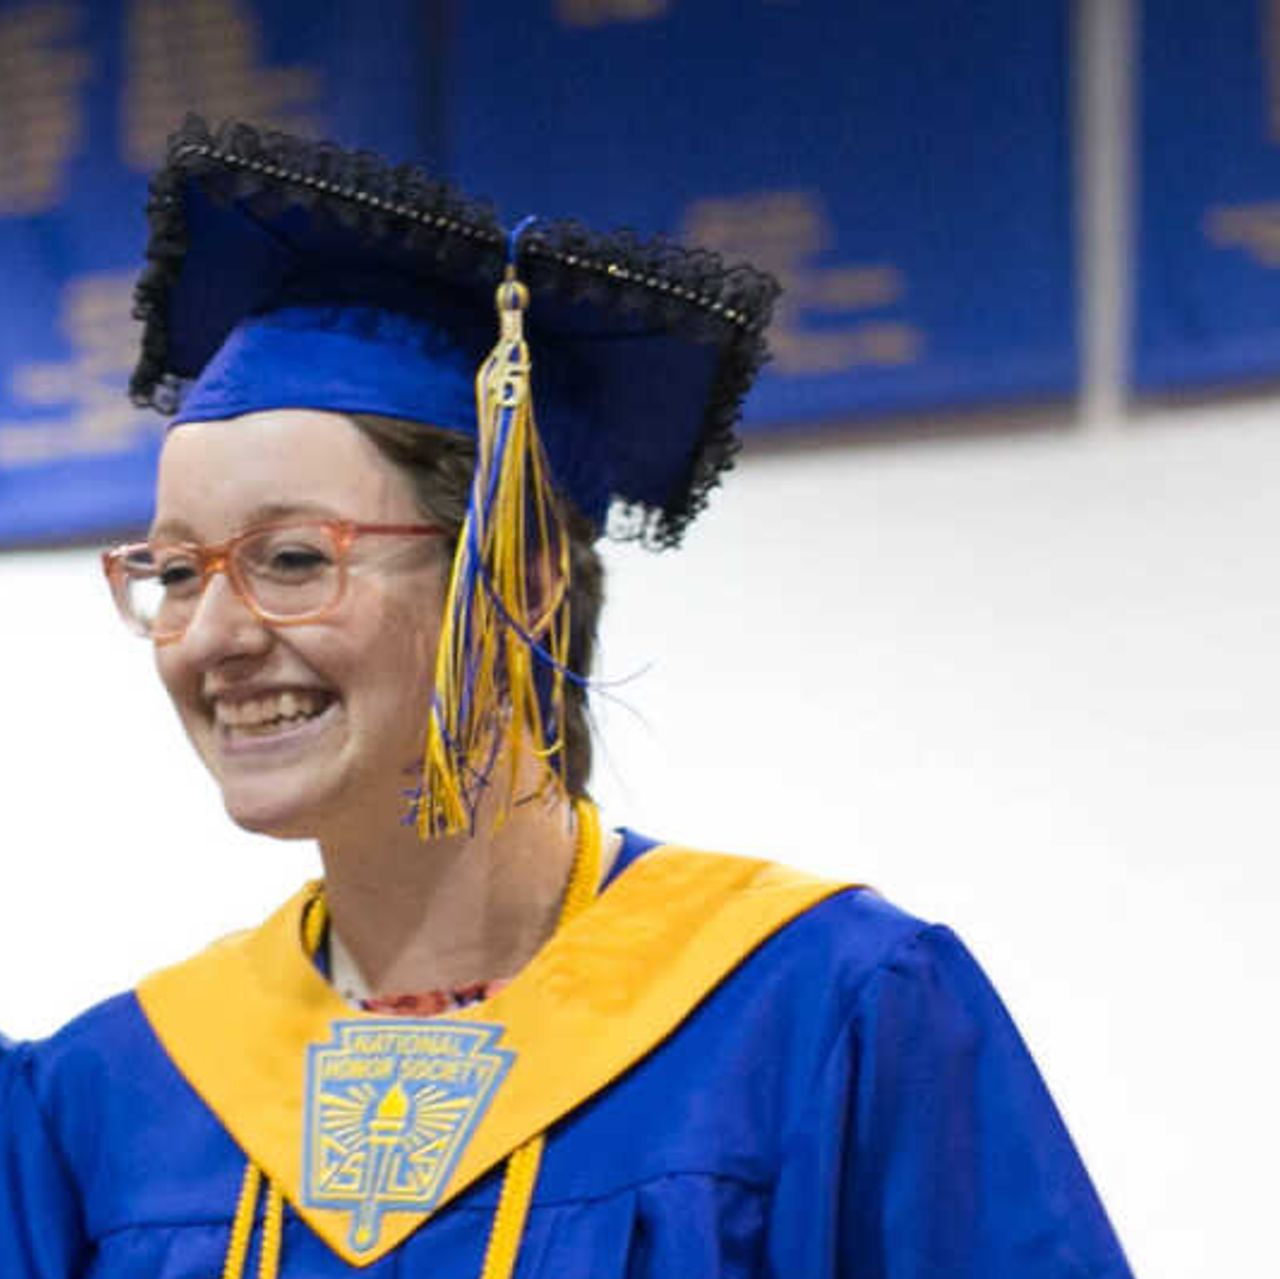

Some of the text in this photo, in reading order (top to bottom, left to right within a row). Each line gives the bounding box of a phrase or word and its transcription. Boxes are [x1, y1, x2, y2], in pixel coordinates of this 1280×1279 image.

[353, 1033, 462, 1057] NATIONAL
[323, 1056, 489, 1083] HONOR SOCIETY
